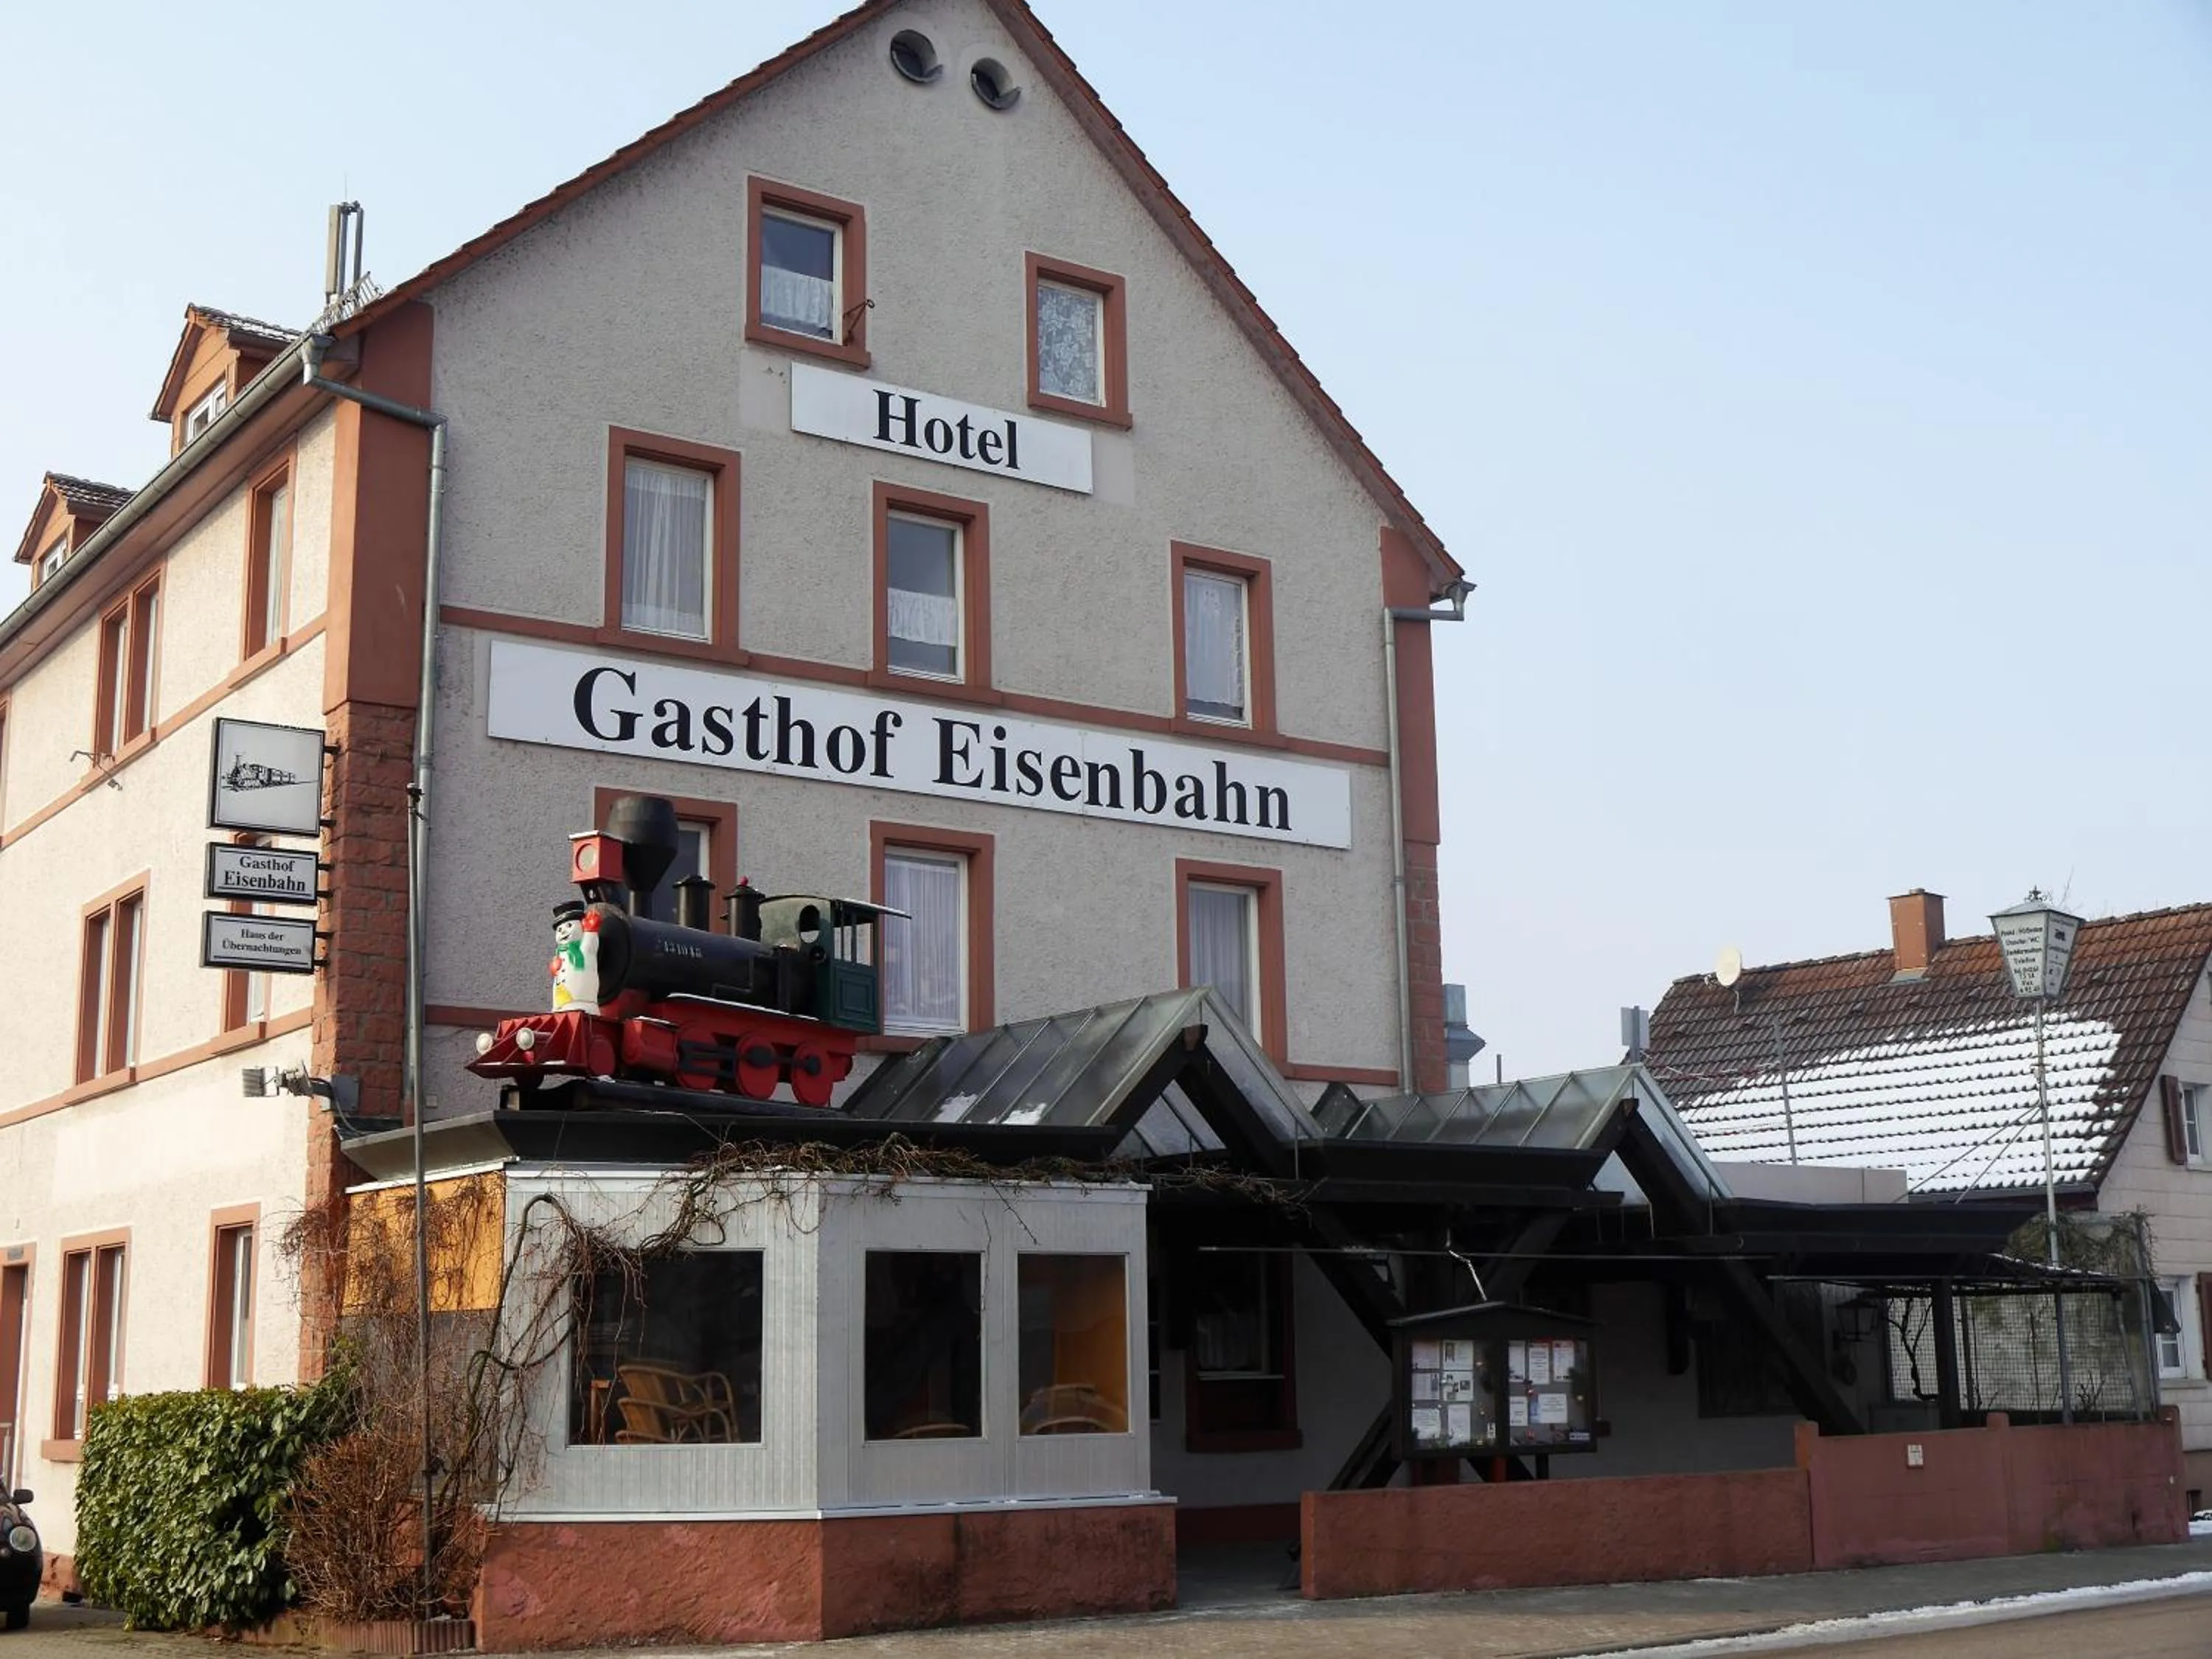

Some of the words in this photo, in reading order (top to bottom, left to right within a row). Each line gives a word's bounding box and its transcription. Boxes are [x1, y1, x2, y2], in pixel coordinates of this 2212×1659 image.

[872, 389, 1020, 470] Hotel
[574, 667, 903, 778] Gasthof
[931, 717, 1293, 831] Eisenbahn
[240, 855, 295, 872] Gasthof
[224, 870, 306, 891] Eisenbahn
[241, 928, 266, 939] Haus
[268, 932, 284, 941] der
